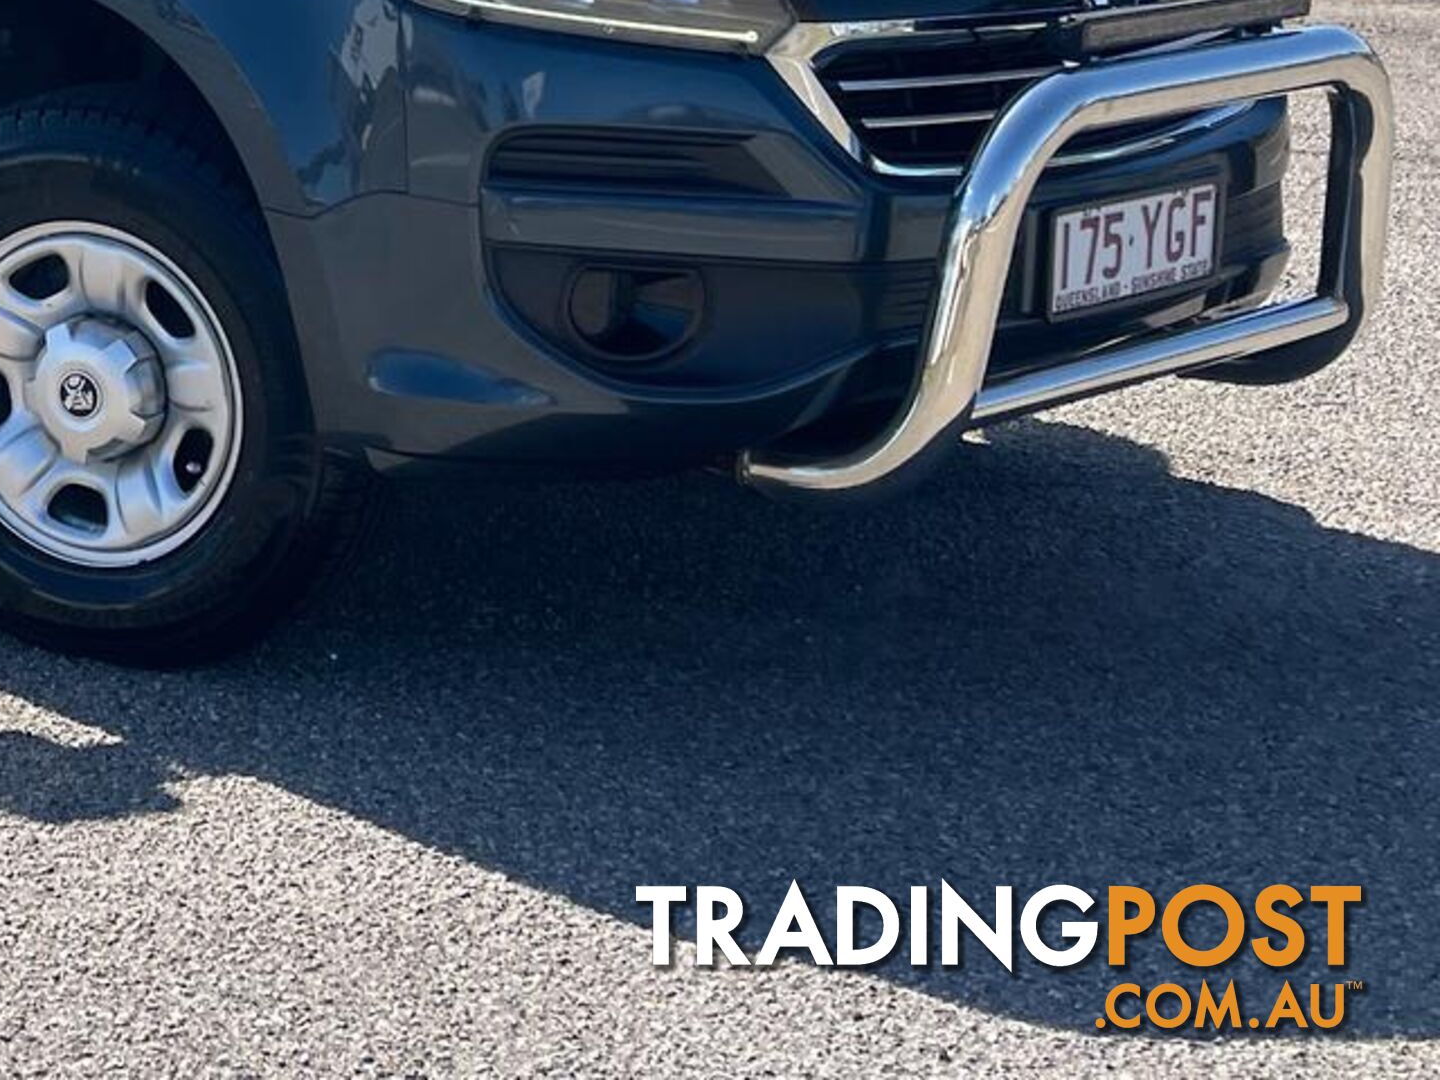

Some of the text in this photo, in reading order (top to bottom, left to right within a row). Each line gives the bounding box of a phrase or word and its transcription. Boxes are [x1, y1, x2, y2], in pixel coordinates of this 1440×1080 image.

[1141, 192, 1213, 270] YGF
[1054, 258, 1209, 311] QUEENSLAND SUNSHINE STATE
